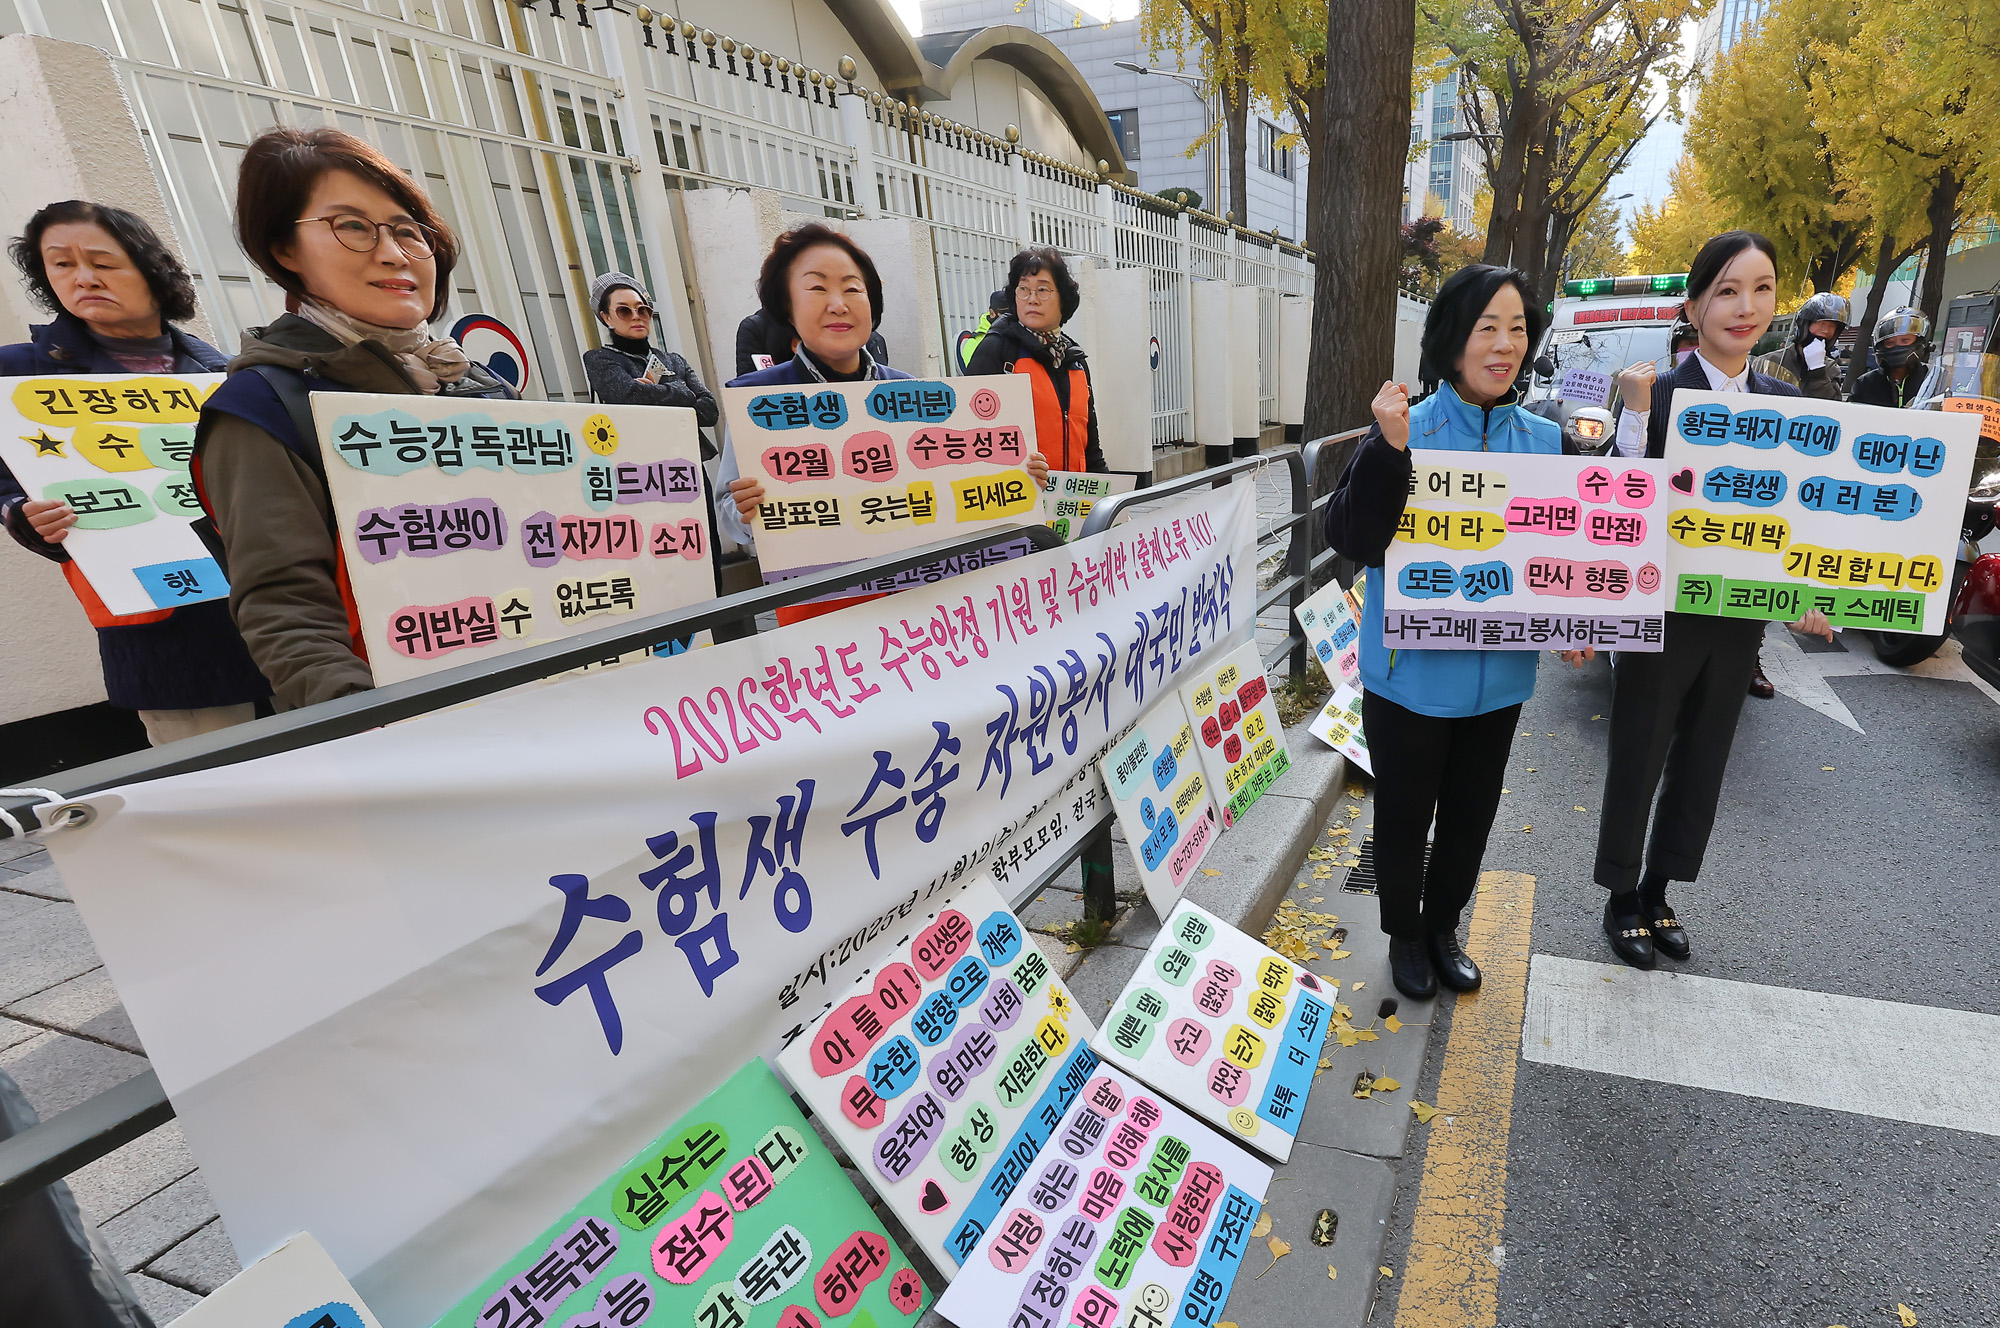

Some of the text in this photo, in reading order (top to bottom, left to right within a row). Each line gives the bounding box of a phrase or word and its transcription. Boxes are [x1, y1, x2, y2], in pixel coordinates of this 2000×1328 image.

[1574, 309, 1620, 325] EMERGENCY
[1620, 307, 1655, 321] MEDICAL
[35, 388, 200, 415] 긴장하지
[752, 391, 952, 428] 수험생 여러분!
[587, 463, 698, 502] 힘드시죠!
[769, 450, 830, 477] 12월
[851, 446, 893, 474] 5일
[64, 489, 141, 514] 보고
[759, 499, 841, 531] 발표일
[963, 481, 1027, 512] 되세요
[1706, 471, 1780, 500] 수험생
[358, 507, 503, 556] 수험생이
[654, 522, 702, 555] 소지
[1508, 505, 1576, 531] 그러면
[1592, 515, 1641, 542] 만점!
[1671, 515, 1786, 550] 수능대박
[1406, 564, 1630, 598] 모든 것이 만사 형통
[1787, 551, 1937, 587] 기원합니다.
[557, 577, 635, 619] 없도록
[1681, 579, 1713, 605] 주)
[1726, 588, 1800, 614] 코리아
[644, 642, 881, 780] 2026학년도
[879, 596, 988, 692] 수능안정
[986, 577, 1037, 645] 기원
[1040, 568, 1063, 628] 및
[1067, 541, 1130, 614] 수능대박
[1186, 511, 1217, 551] NO!
[1195, 686, 1213, 709] 수험생
[1203, 726, 1220, 743] 작년
[1239, 681, 1265, 709] 탐구영역
[1156, 751, 1175, 782] 수험생
[1226, 735, 1240, 758] 위반
[1225, 755, 1254, 791] 실수하지
[1251, 769, 1272, 792] 머무는
[1273, 752, 1289, 773] 교회
[1071, 788, 1097, 822] 전국
[1176, 776, 1203, 815] 연락하세요
[535, 779, 816, 1056] 수험생
[841, 721, 961, 880] 수송
[976, 632, 1117, 801] 자원봉사
[1125, 586, 1187, 706] 대국민
[823, 914, 972, 1066] 아들아! 인생은
[915, 959, 988, 1043] 방향으로
[981, 922, 1017, 960] 계속
[1114, 916, 1207, 1049] 예쁜 딸! 오늘 정말
[1262, 961, 1288, 990] 먹자.
[1174, 964, 1235, 1056] 수고 많았어.
[1253, 991, 1281, 1024] 많이
[880, 952, 1049, 1178] 움직여 엄마는 너희 꿈을
[1269, 998, 1325, 1120] 틱톡 더 스토리
[950, 1022, 1066, 1172] 항상 지원한다.
[1064, 1109, 1106, 1156] 아들!
[1082, 1170, 1123, 1219] 마음
[1107, 1099, 1159, 1168] 이해해!
[658, 1204, 730, 1279] 점수
[728, 1131, 803, 1208] 된다.
[955, 1219, 985, 1259] 주)
[990, 1131, 1038, 1207] 코리아
[1098, 1207, 1155, 1288] 노력에
[1140, 1138, 1190, 1205] 감사를
[1164, 1166, 1221, 1261] 사랑한다.
[483, 1128, 727, 1328] 감독관 실수는
[822, 1236, 885, 1305] 하라.
[1184, 1193, 1254, 1327] 인명 구조단
